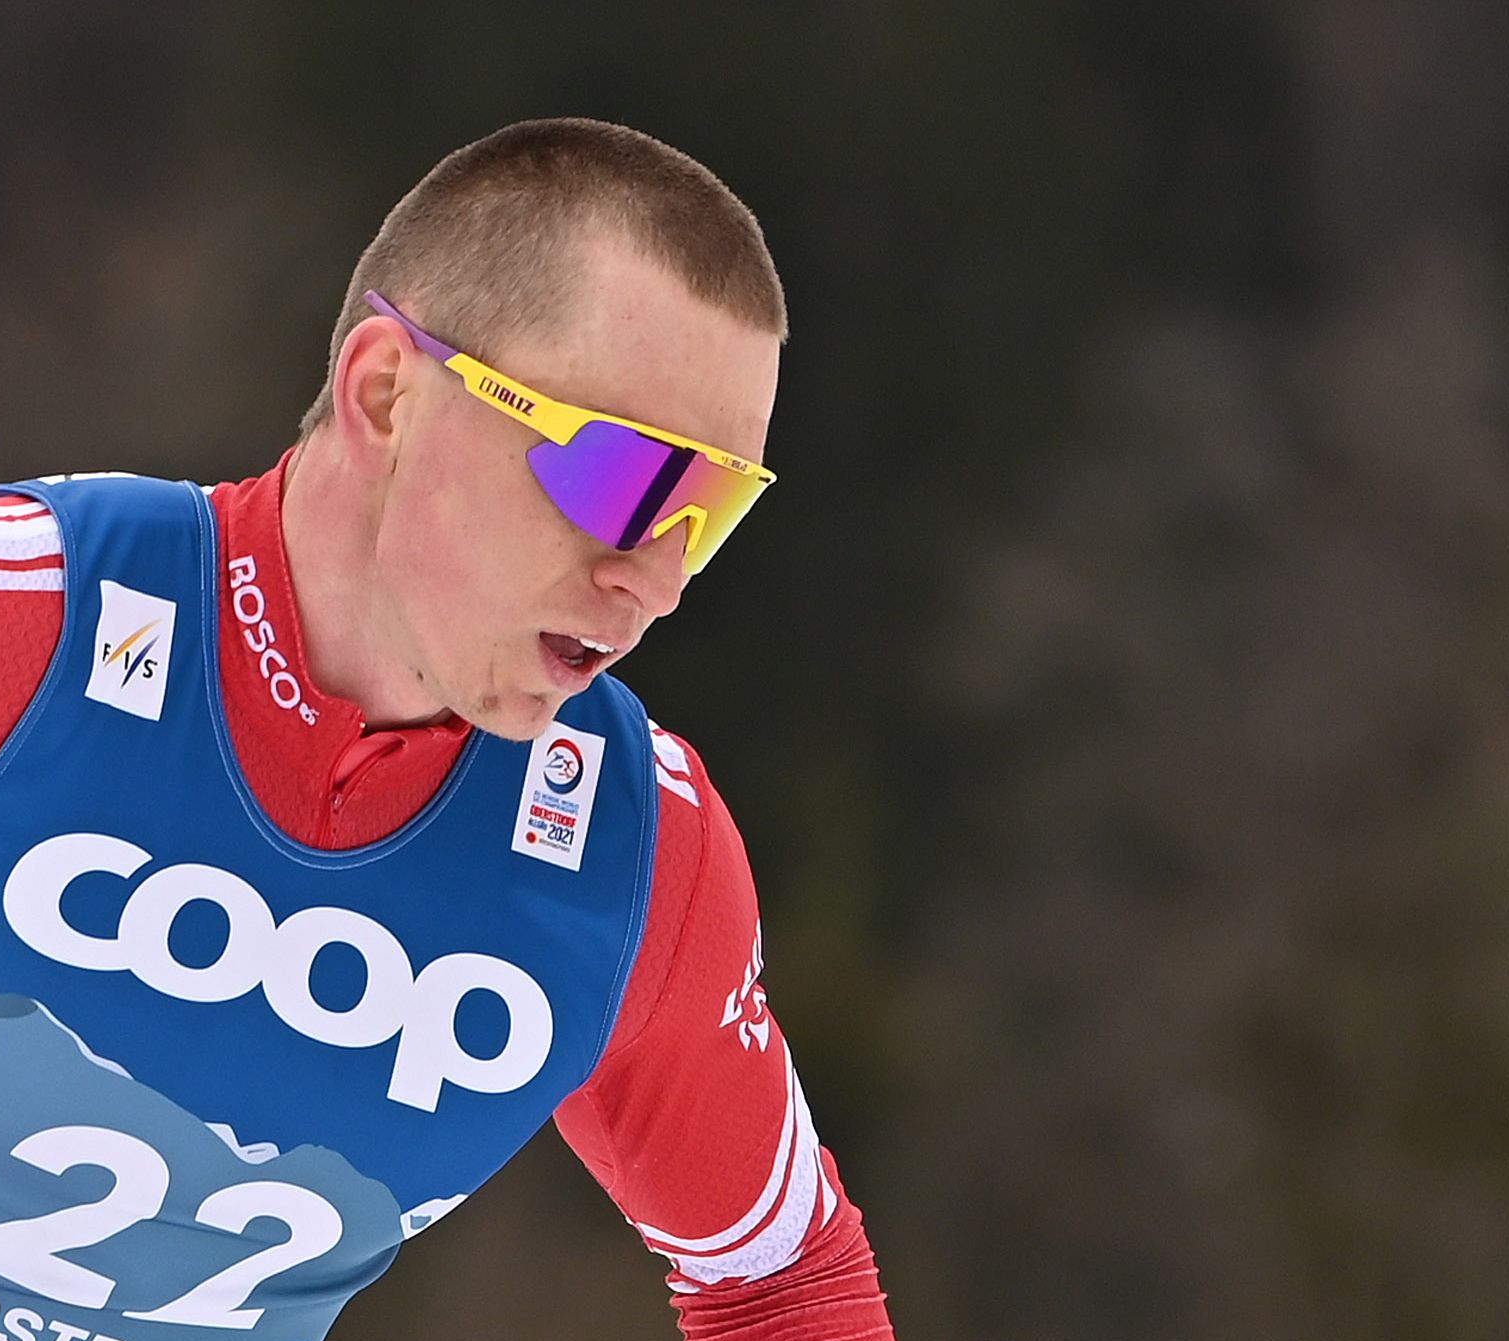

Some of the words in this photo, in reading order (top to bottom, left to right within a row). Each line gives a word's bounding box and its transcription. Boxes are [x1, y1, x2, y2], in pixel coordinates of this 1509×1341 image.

[498, 387, 535, 416] BLIZ
[102, 643, 158, 680] FIS
[547, 823, 575, 846] 2021
[2, 832, 554, 1113] coop
